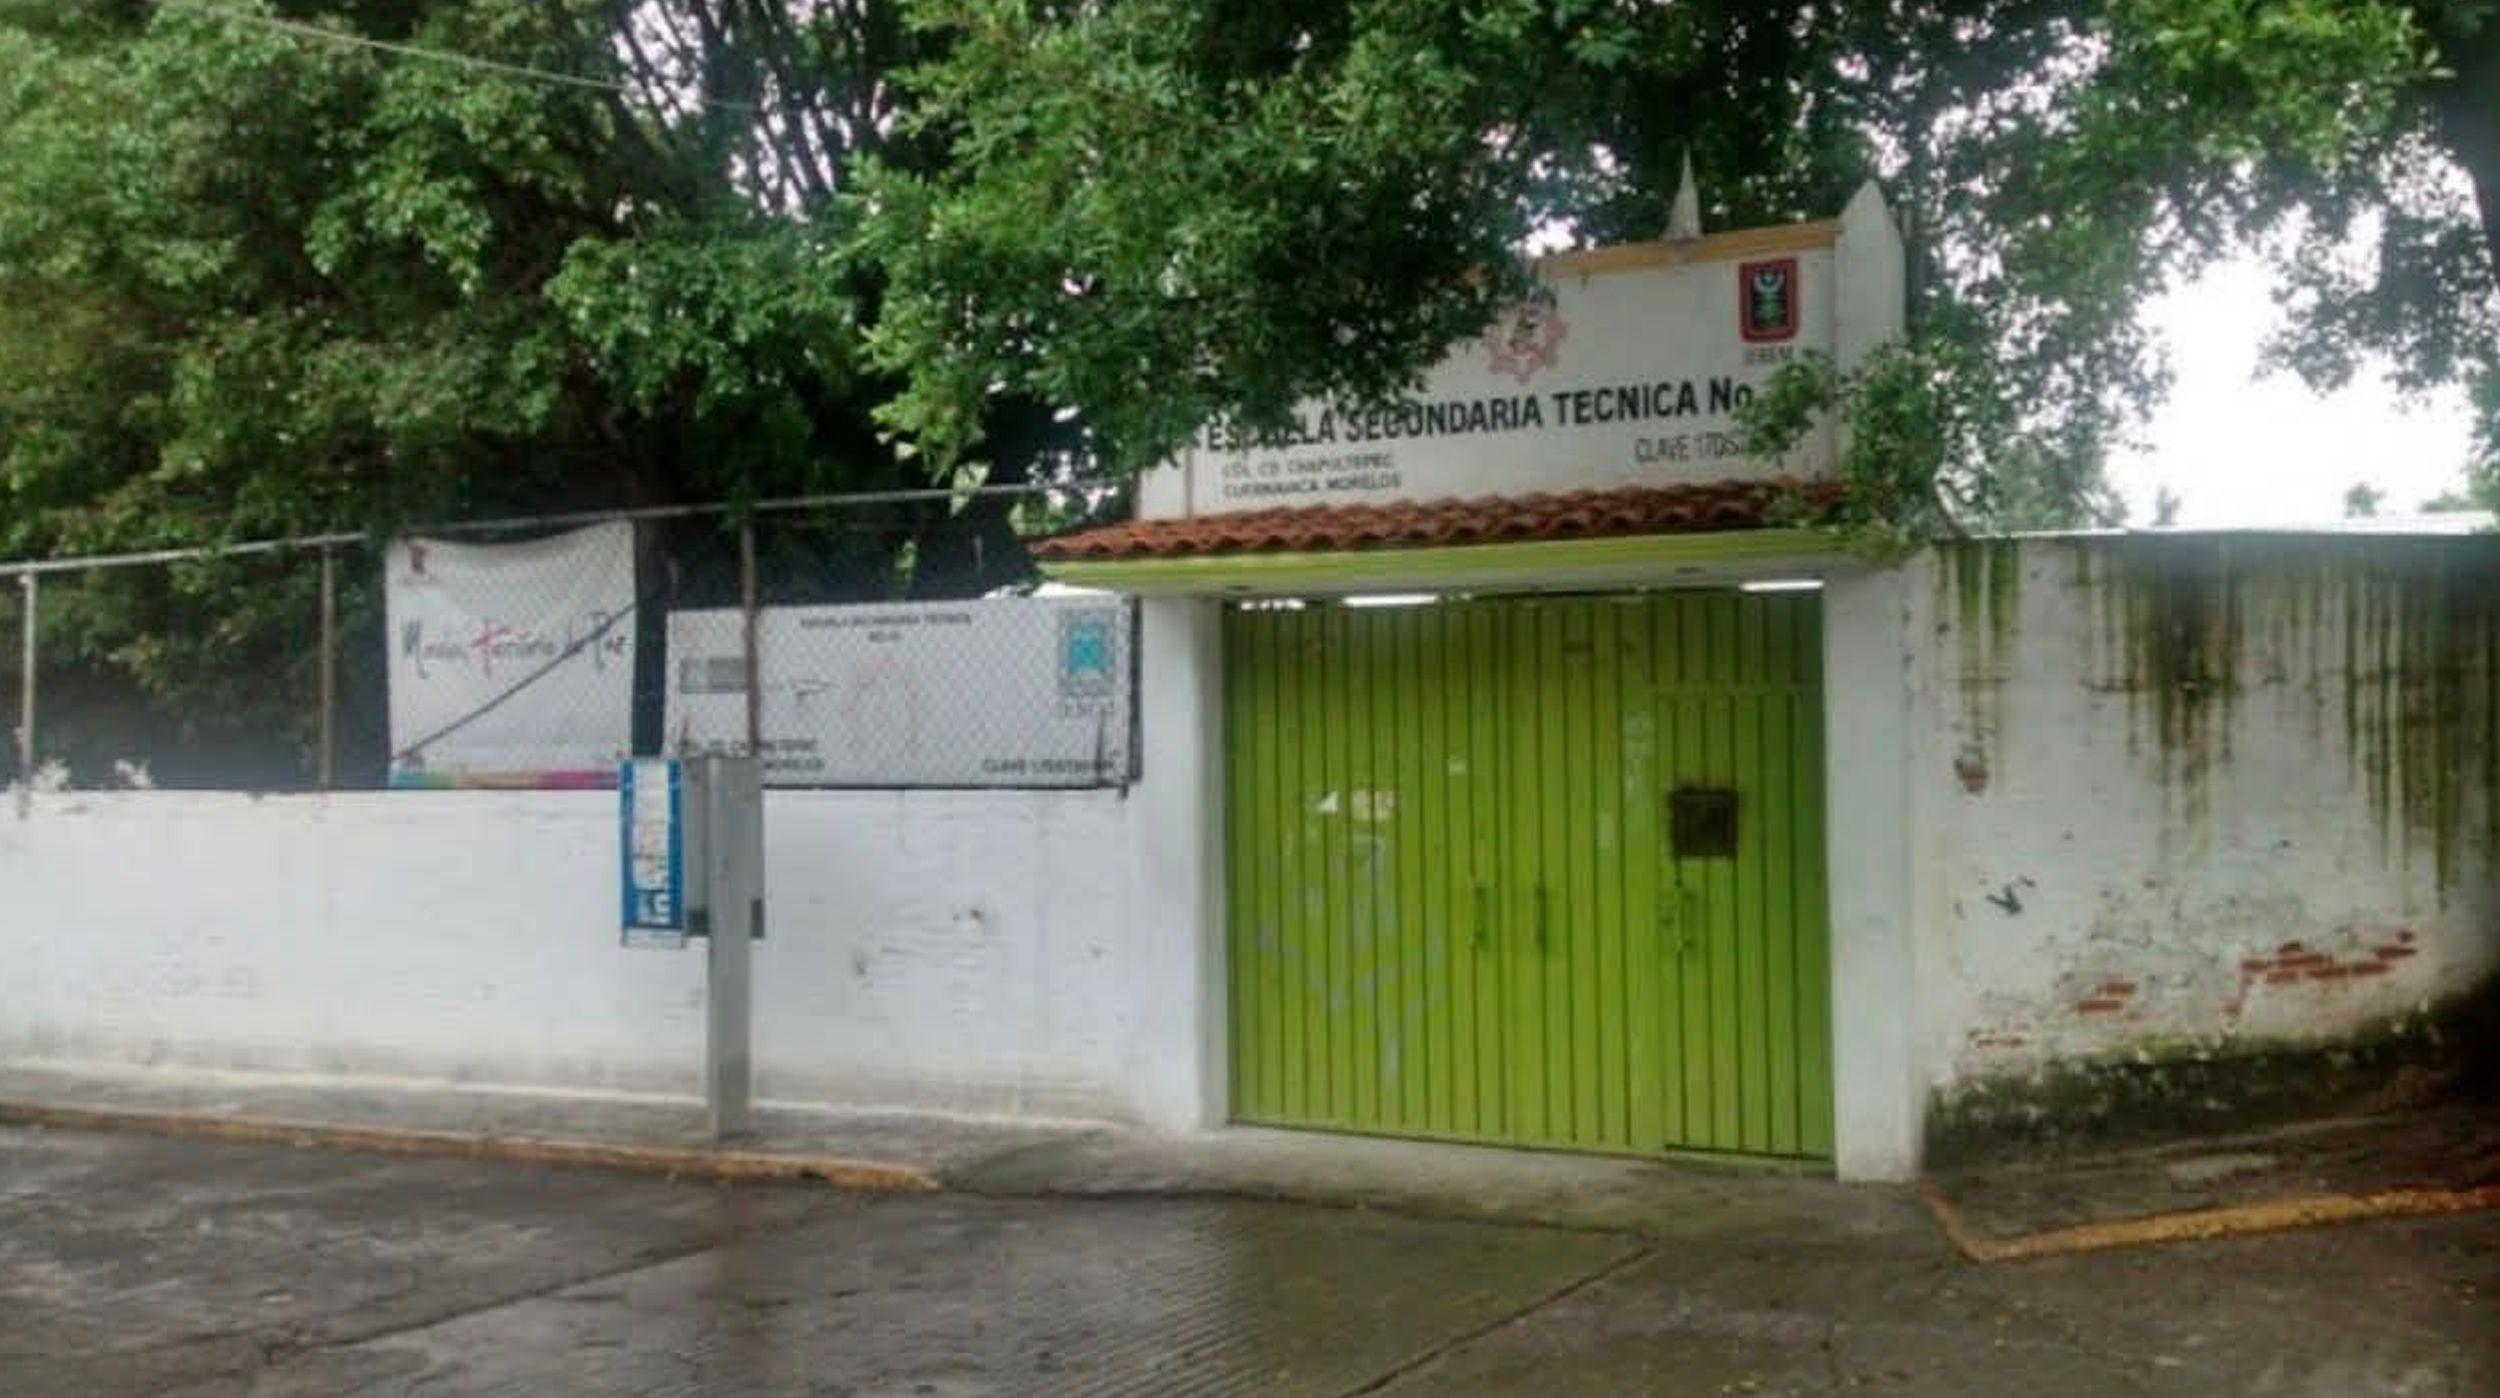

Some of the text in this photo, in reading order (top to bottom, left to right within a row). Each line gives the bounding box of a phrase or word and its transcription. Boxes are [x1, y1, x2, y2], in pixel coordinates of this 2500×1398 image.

[1208, 404, 1337, 452] ESELA
[1345, 393, 1544, 442] SECUNDARIA
[1552, 380, 1698, 425] TECNICA
[1635, 434, 1690, 464] CLAVE
